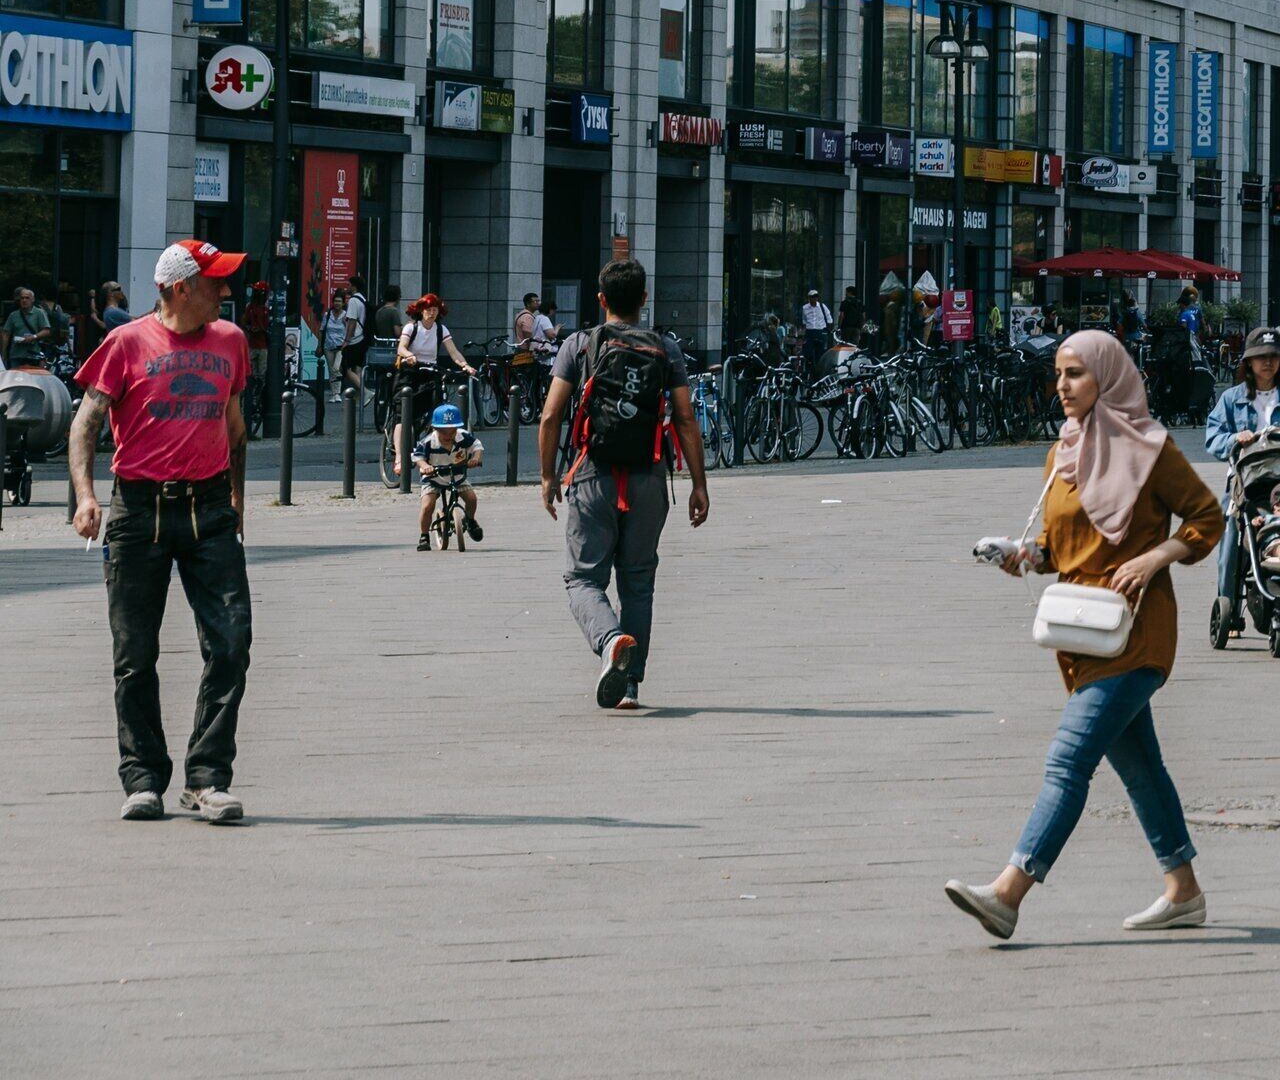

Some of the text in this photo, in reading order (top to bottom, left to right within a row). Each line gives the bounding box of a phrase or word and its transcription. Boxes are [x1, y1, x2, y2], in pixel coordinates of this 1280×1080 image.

[440, 3, 470, 21] FRISEUR
[0, 31, 132, 114] CATHLON
[483, 90, 500, 107] TASTY
[1154, 50, 1170, 146] DECATHLON
[1197, 54, 1212, 146] DECATHLON
[586, 104, 608, 130] JYSK
[664, 113, 722, 146] ROSSMANN
[739, 124, 765, 132] LUSH
[852, 139, 885, 154] liberty
[922, 141, 943, 149] aktiv
[195, 158, 219, 176] BEZIRKS
[919, 162, 944, 170] Markt
[194, 178, 220, 199] apotheke
[913, 207, 944, 227] ATHAUS
[145, 351, 232, 379] WEEKEND
[148, 400, 225, 420] WARRIORS
